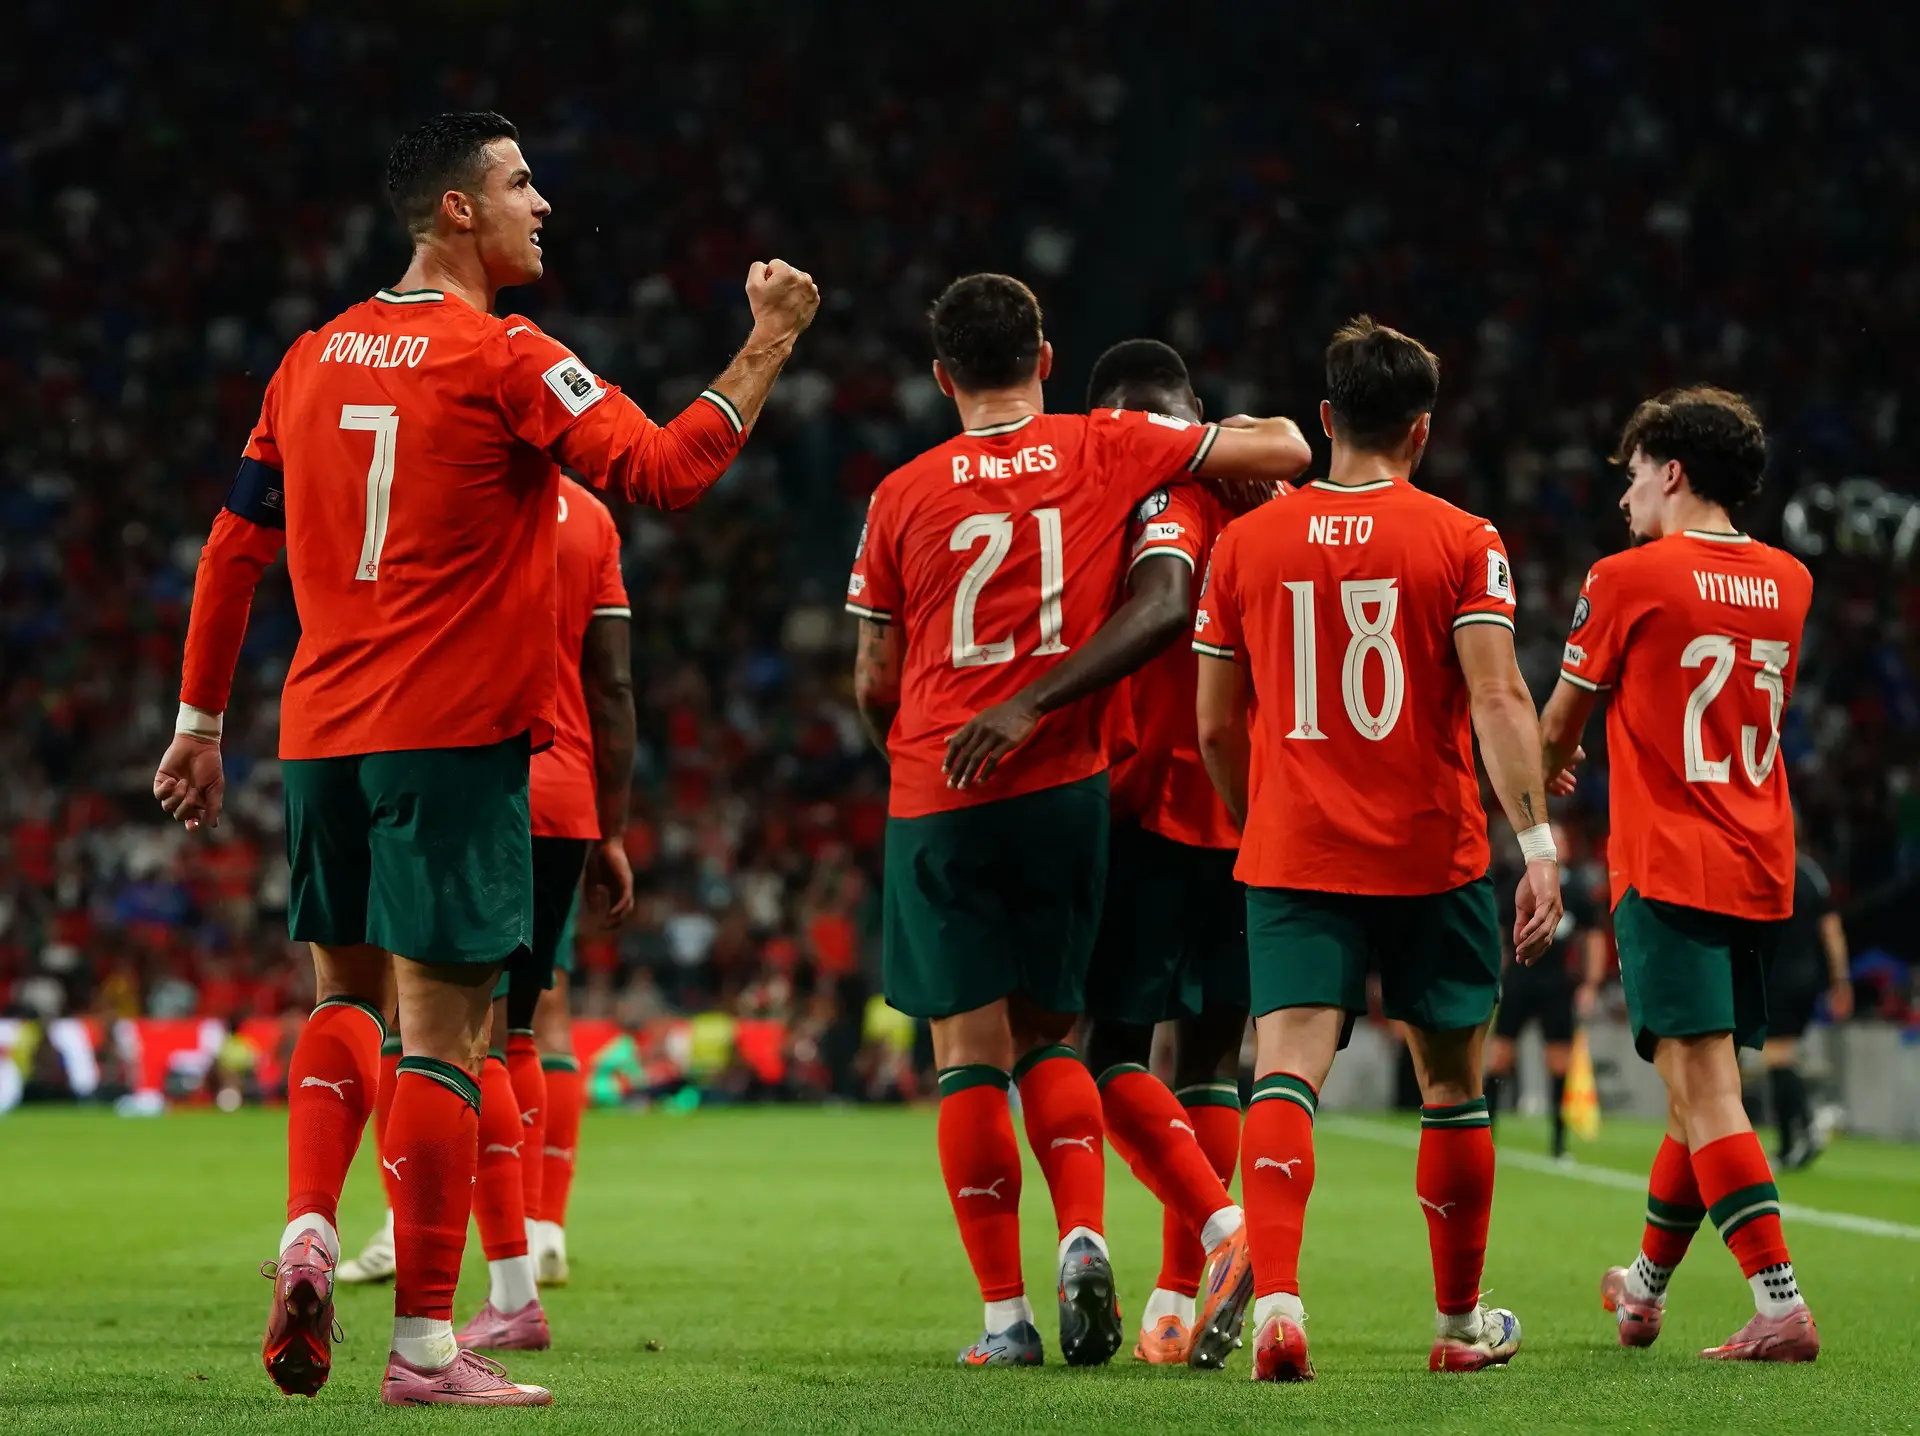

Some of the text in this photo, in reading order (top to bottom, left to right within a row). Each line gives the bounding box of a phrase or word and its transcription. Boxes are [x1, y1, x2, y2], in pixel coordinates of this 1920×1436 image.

[319, 331, 429, 368] RONALDO
[339, 404, 399, 581] 7
[952, 444, 1057, 484] R. NEVES
[1307, 515, 1374, 546] NETO
[949, 508, 1070, 668] 21
[1692, 570, 1779, 610] VITINHA
[1282, 578, 1405, 741] 18
[1680, 634, 1790, 787] 23
